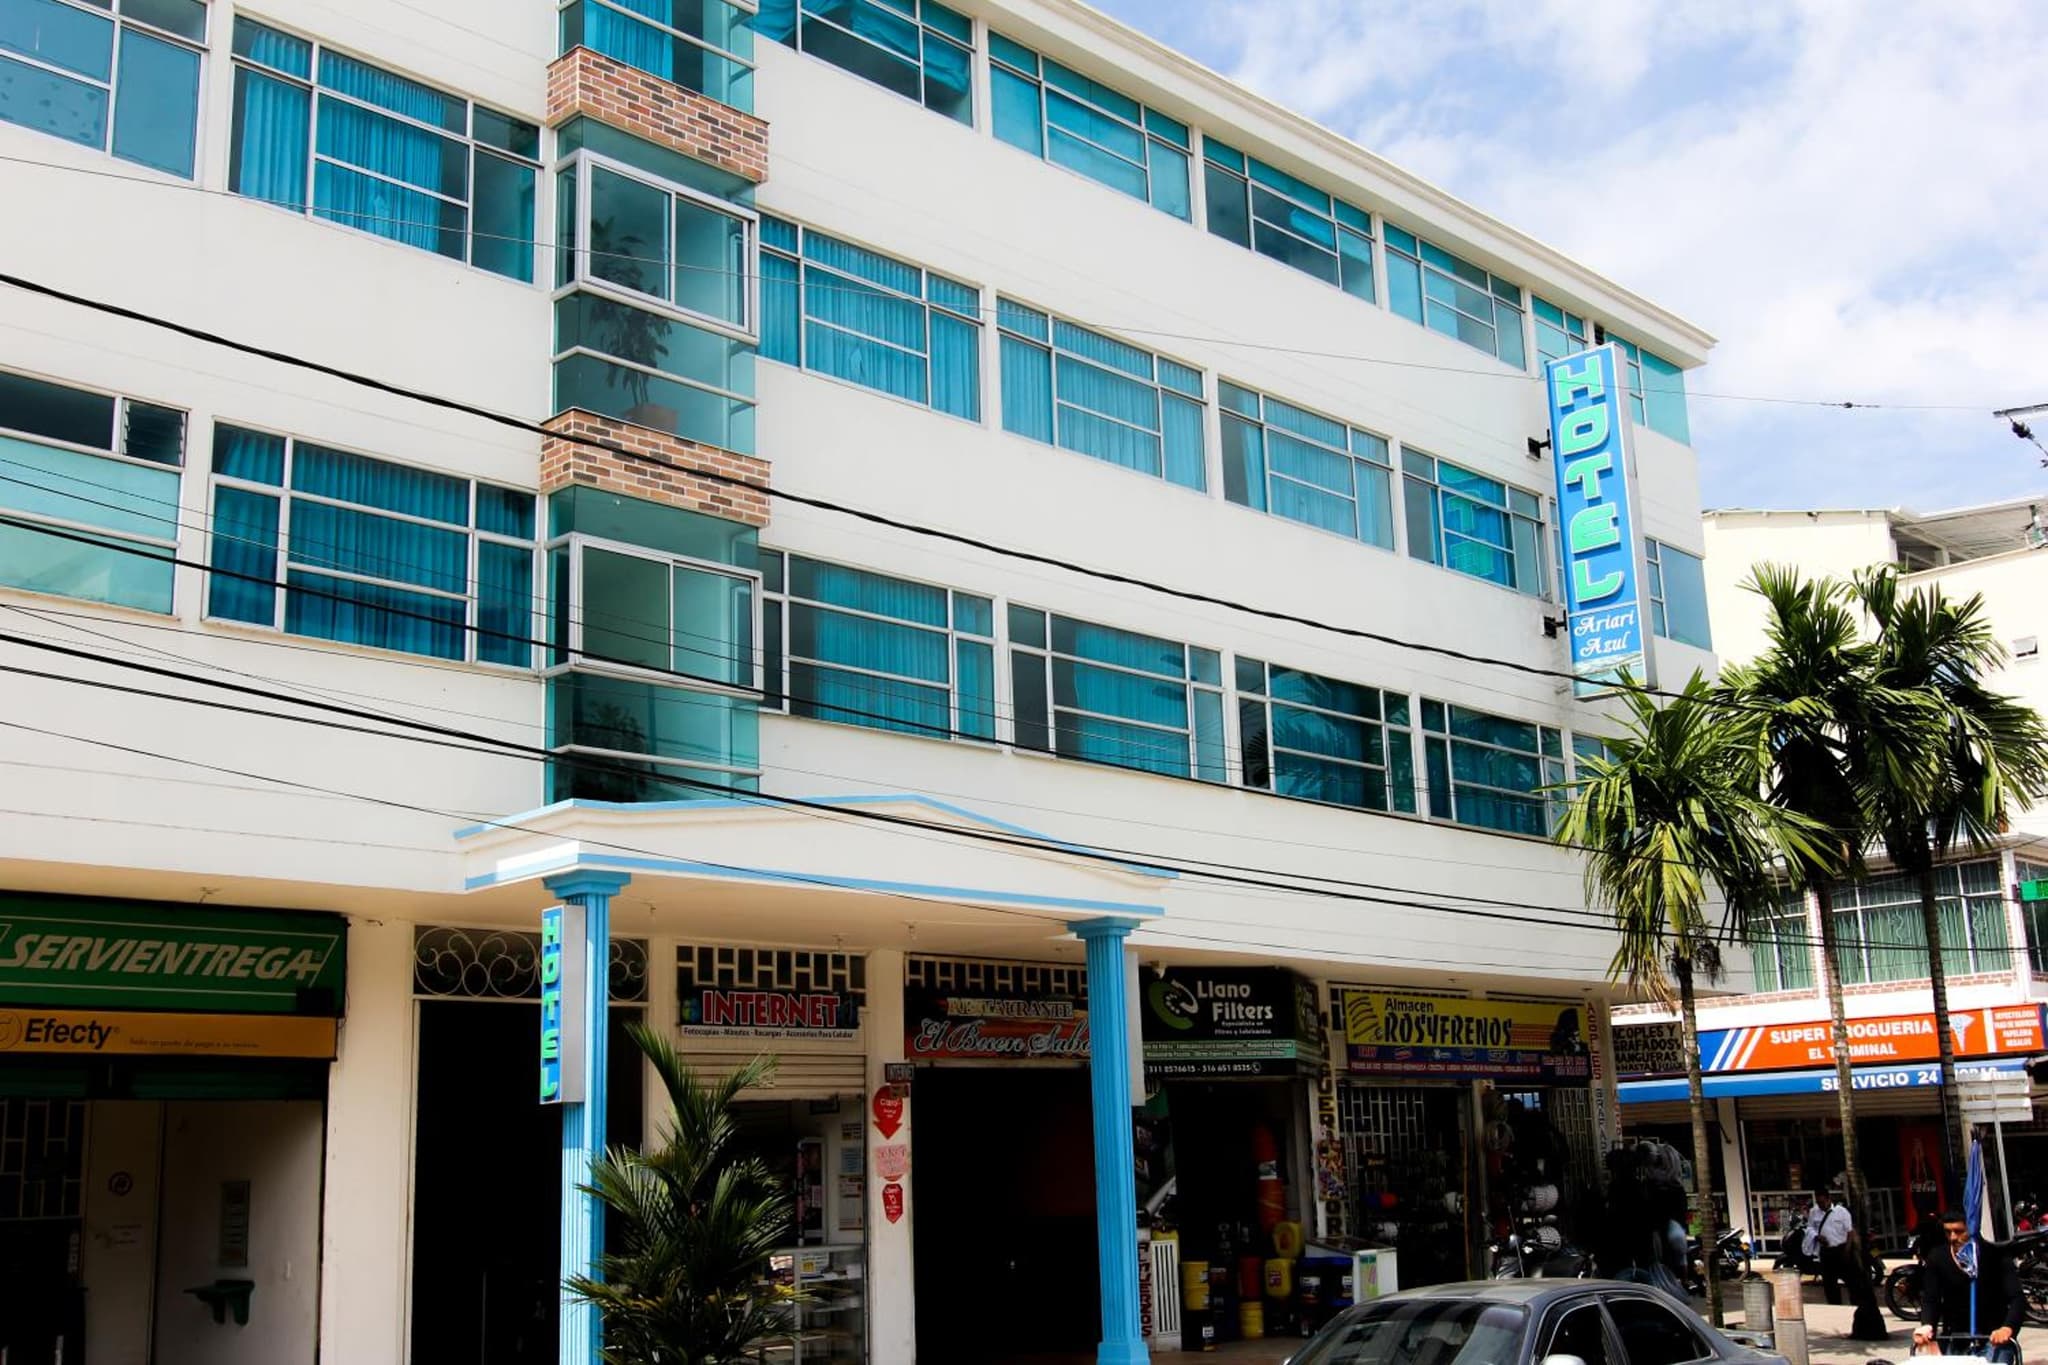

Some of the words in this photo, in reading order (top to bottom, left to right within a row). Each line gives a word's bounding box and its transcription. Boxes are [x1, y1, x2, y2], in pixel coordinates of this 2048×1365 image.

[1554, 354, 1625, 604] HOTEL
[1574, 609, 1636, 638] Ariari
[1580, 631, 1629, 659] Azul
[0, 934, 322, 980] SERVIENTREGA
[1197, 979, 1251, 999] Llano
[541, 915, 560, 1098] HOTEL
[702, 990, 841, 1028] INTERNET
[947, 997, 1074, 1019] RESTAURANTE
[1212, 1001, 1274, 1022] Filters
[1384, 998, 1434, 1013] Almacen
[25, 1018, 112, 1049] Efecty
[914, 1017, 951, 1052] El
[947, 1018, 1025, 1053] Buen
[1027, 1017, 1089, 1056] Sabo
[1384, 1013, 1513, 1046] ROSYFRENOS
[1770, 1027, 1825, 1044] SUPER
[1830, 1019, 1933, 1039] ROGUERIA
[1808, 1047, 1825, 1060] EL
[1827, 1042, 1898, 1059] TRMINAL
[1918, 1071, 1938, 1085] 24
